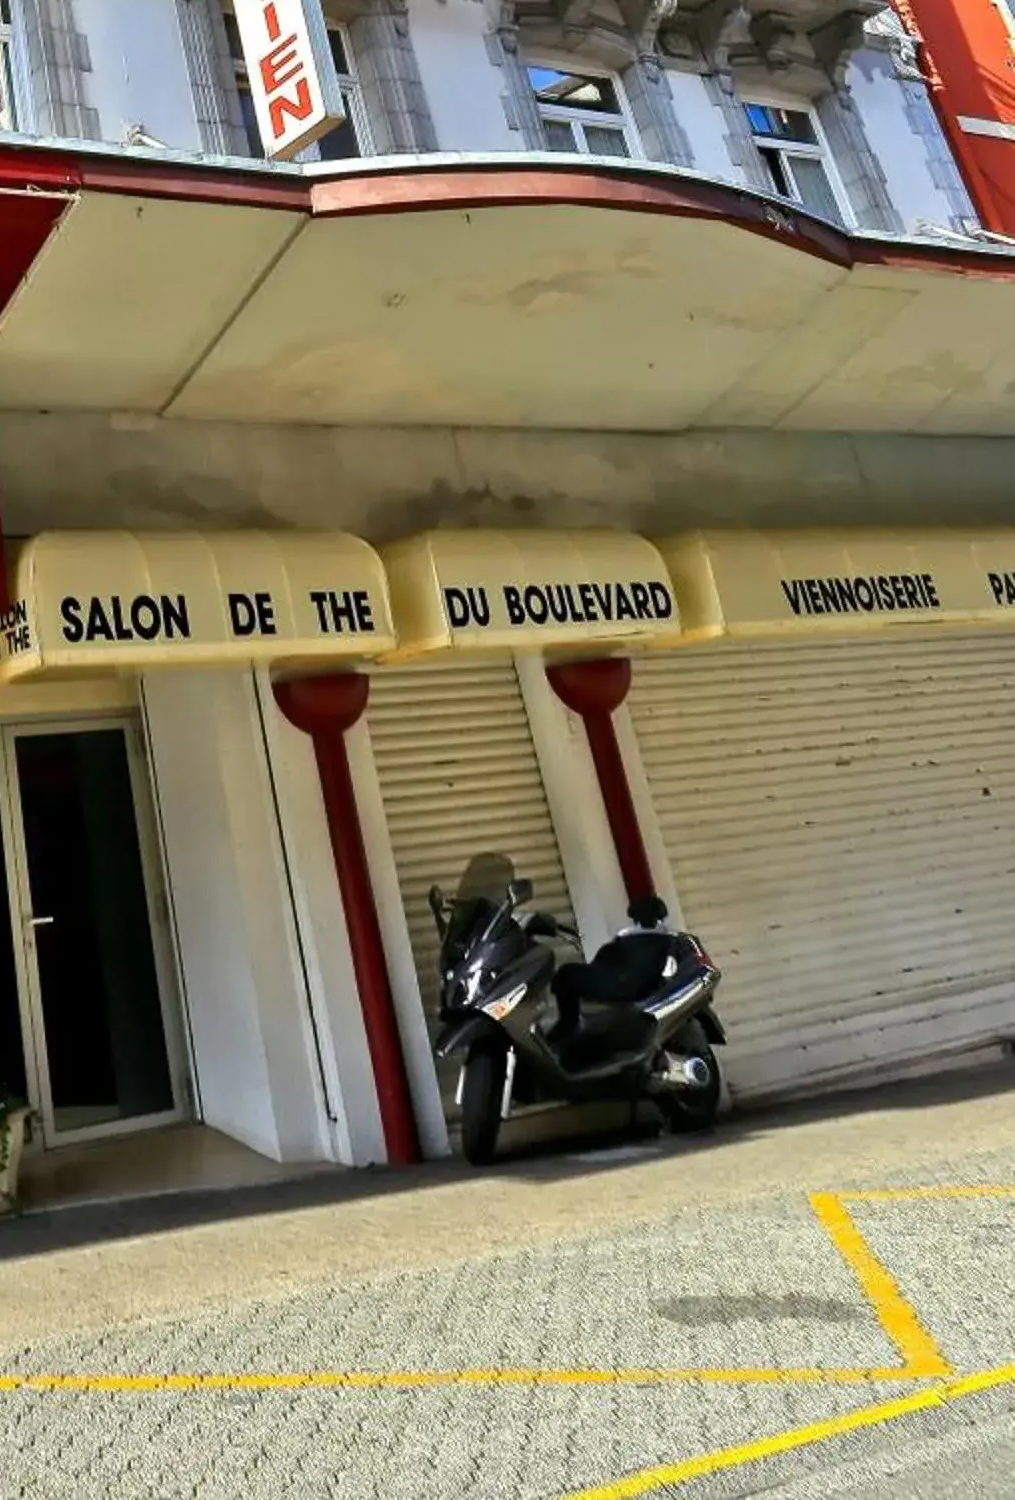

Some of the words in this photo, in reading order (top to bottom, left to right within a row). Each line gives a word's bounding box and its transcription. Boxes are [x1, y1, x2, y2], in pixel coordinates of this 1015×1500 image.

[444, 587, 490, 628] DU
[503, 581, 673, 625] BOULEVARD
[781, 574, 940, 615] VIENNOISERIE
[60, 594, 191, 643] SALON
[228, 592, 277, 636] DE
[309, 591, 375, 633] THE
[6, 625, 30, 655] THE
